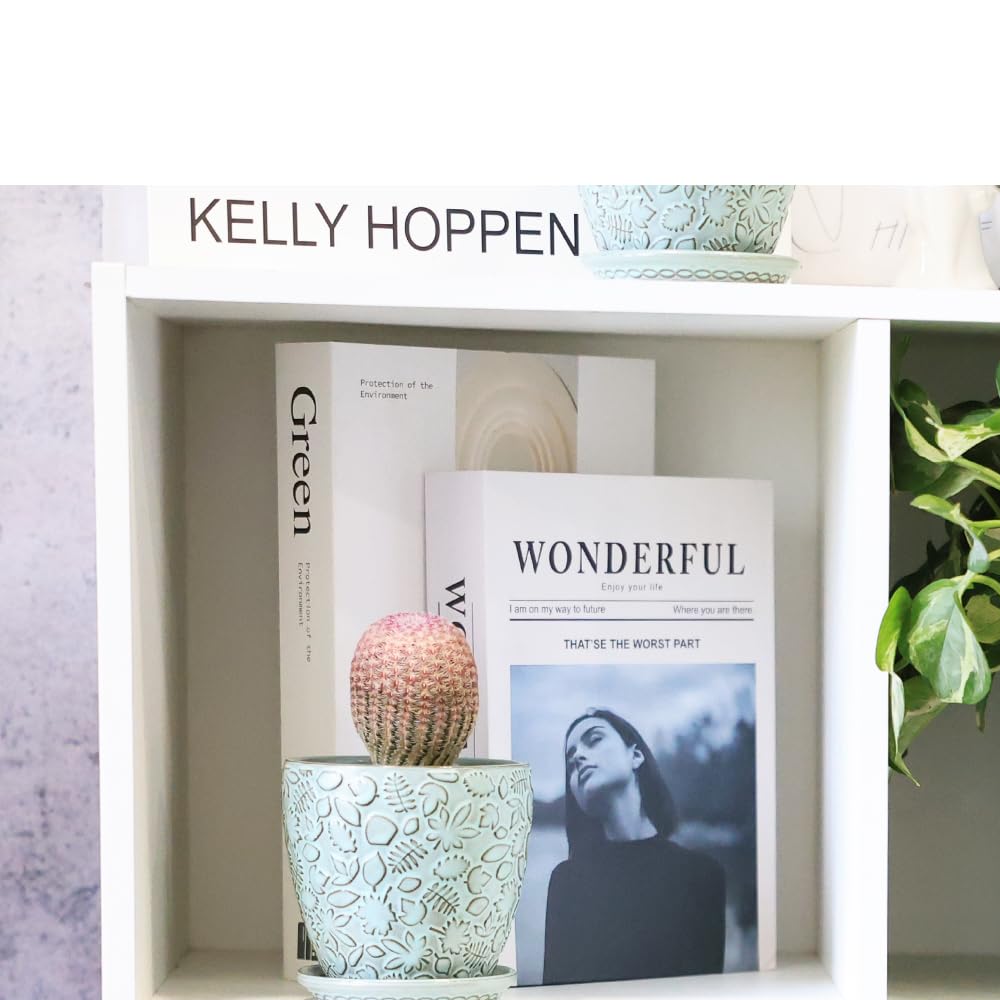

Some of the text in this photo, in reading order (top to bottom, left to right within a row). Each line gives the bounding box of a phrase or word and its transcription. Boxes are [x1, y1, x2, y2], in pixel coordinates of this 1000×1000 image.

[189, 197, 580, 256] KELLY HOPPEN
[360, 379, 434, 390] Protection of the
[360, 390, 408, 400] Environment
[290, 386, 317, 538] Green
[512, 540, 746, 575] WONDERFUL
[601, 582, 663, 593] Enjoy your life
[541, 606, 553, 615] my
[556, 606, 572, 615] way
[573, 605, 581, 613] to
[583, 605, 606, 613] future
[673, 605, 699, 614] Where
[701, 607, 715, 616] you
[732, 606, 753, 614] there
[610, 639, 630, 649] THE
[633, 639, 671, 649] WORST
[673, 639, 701, 649] PART
